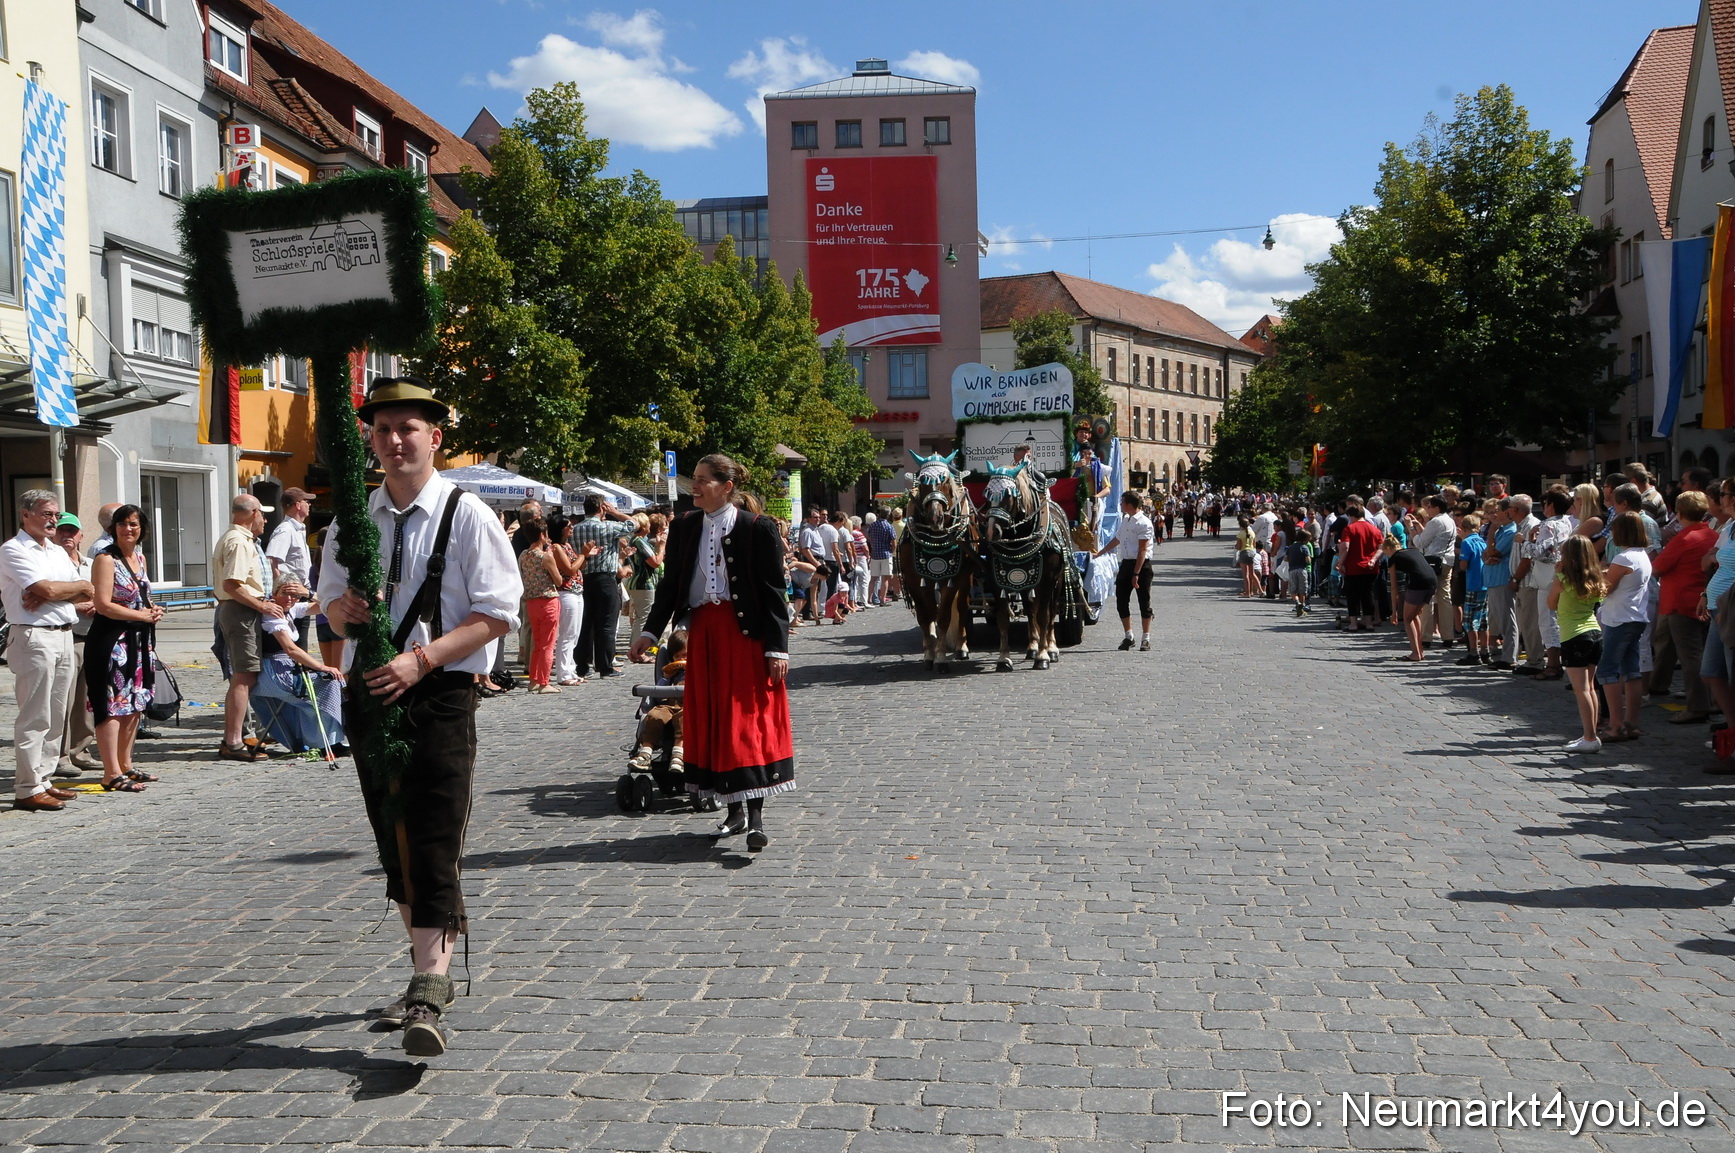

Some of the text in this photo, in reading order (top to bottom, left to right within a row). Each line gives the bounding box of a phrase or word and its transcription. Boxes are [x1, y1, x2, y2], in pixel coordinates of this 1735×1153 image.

[816, 202, 863, 217] Danke
[815, 222, 894, 233] für Ihr Vertrauen
[250, 233, 304, 248] Theaterverein
[816, 235, 887, 246] und Ihre Treue.
[252, 240, 335, 262] Schloßspiele
[255, 259, 308, 274] Neumarkt e.V.
[855, 268, 900, 287] 175
[857, 287, 900, 299] JAHRE
[963, 370, 1058, 391] WIR BRINGEN
[990, 391, 1007, 399] das
[963, 393, 1072, 418] OLYMPISCHE FEUER
[668, 454, 674, 474] P
[479, 485, 525, 495] Winkler Bräu
